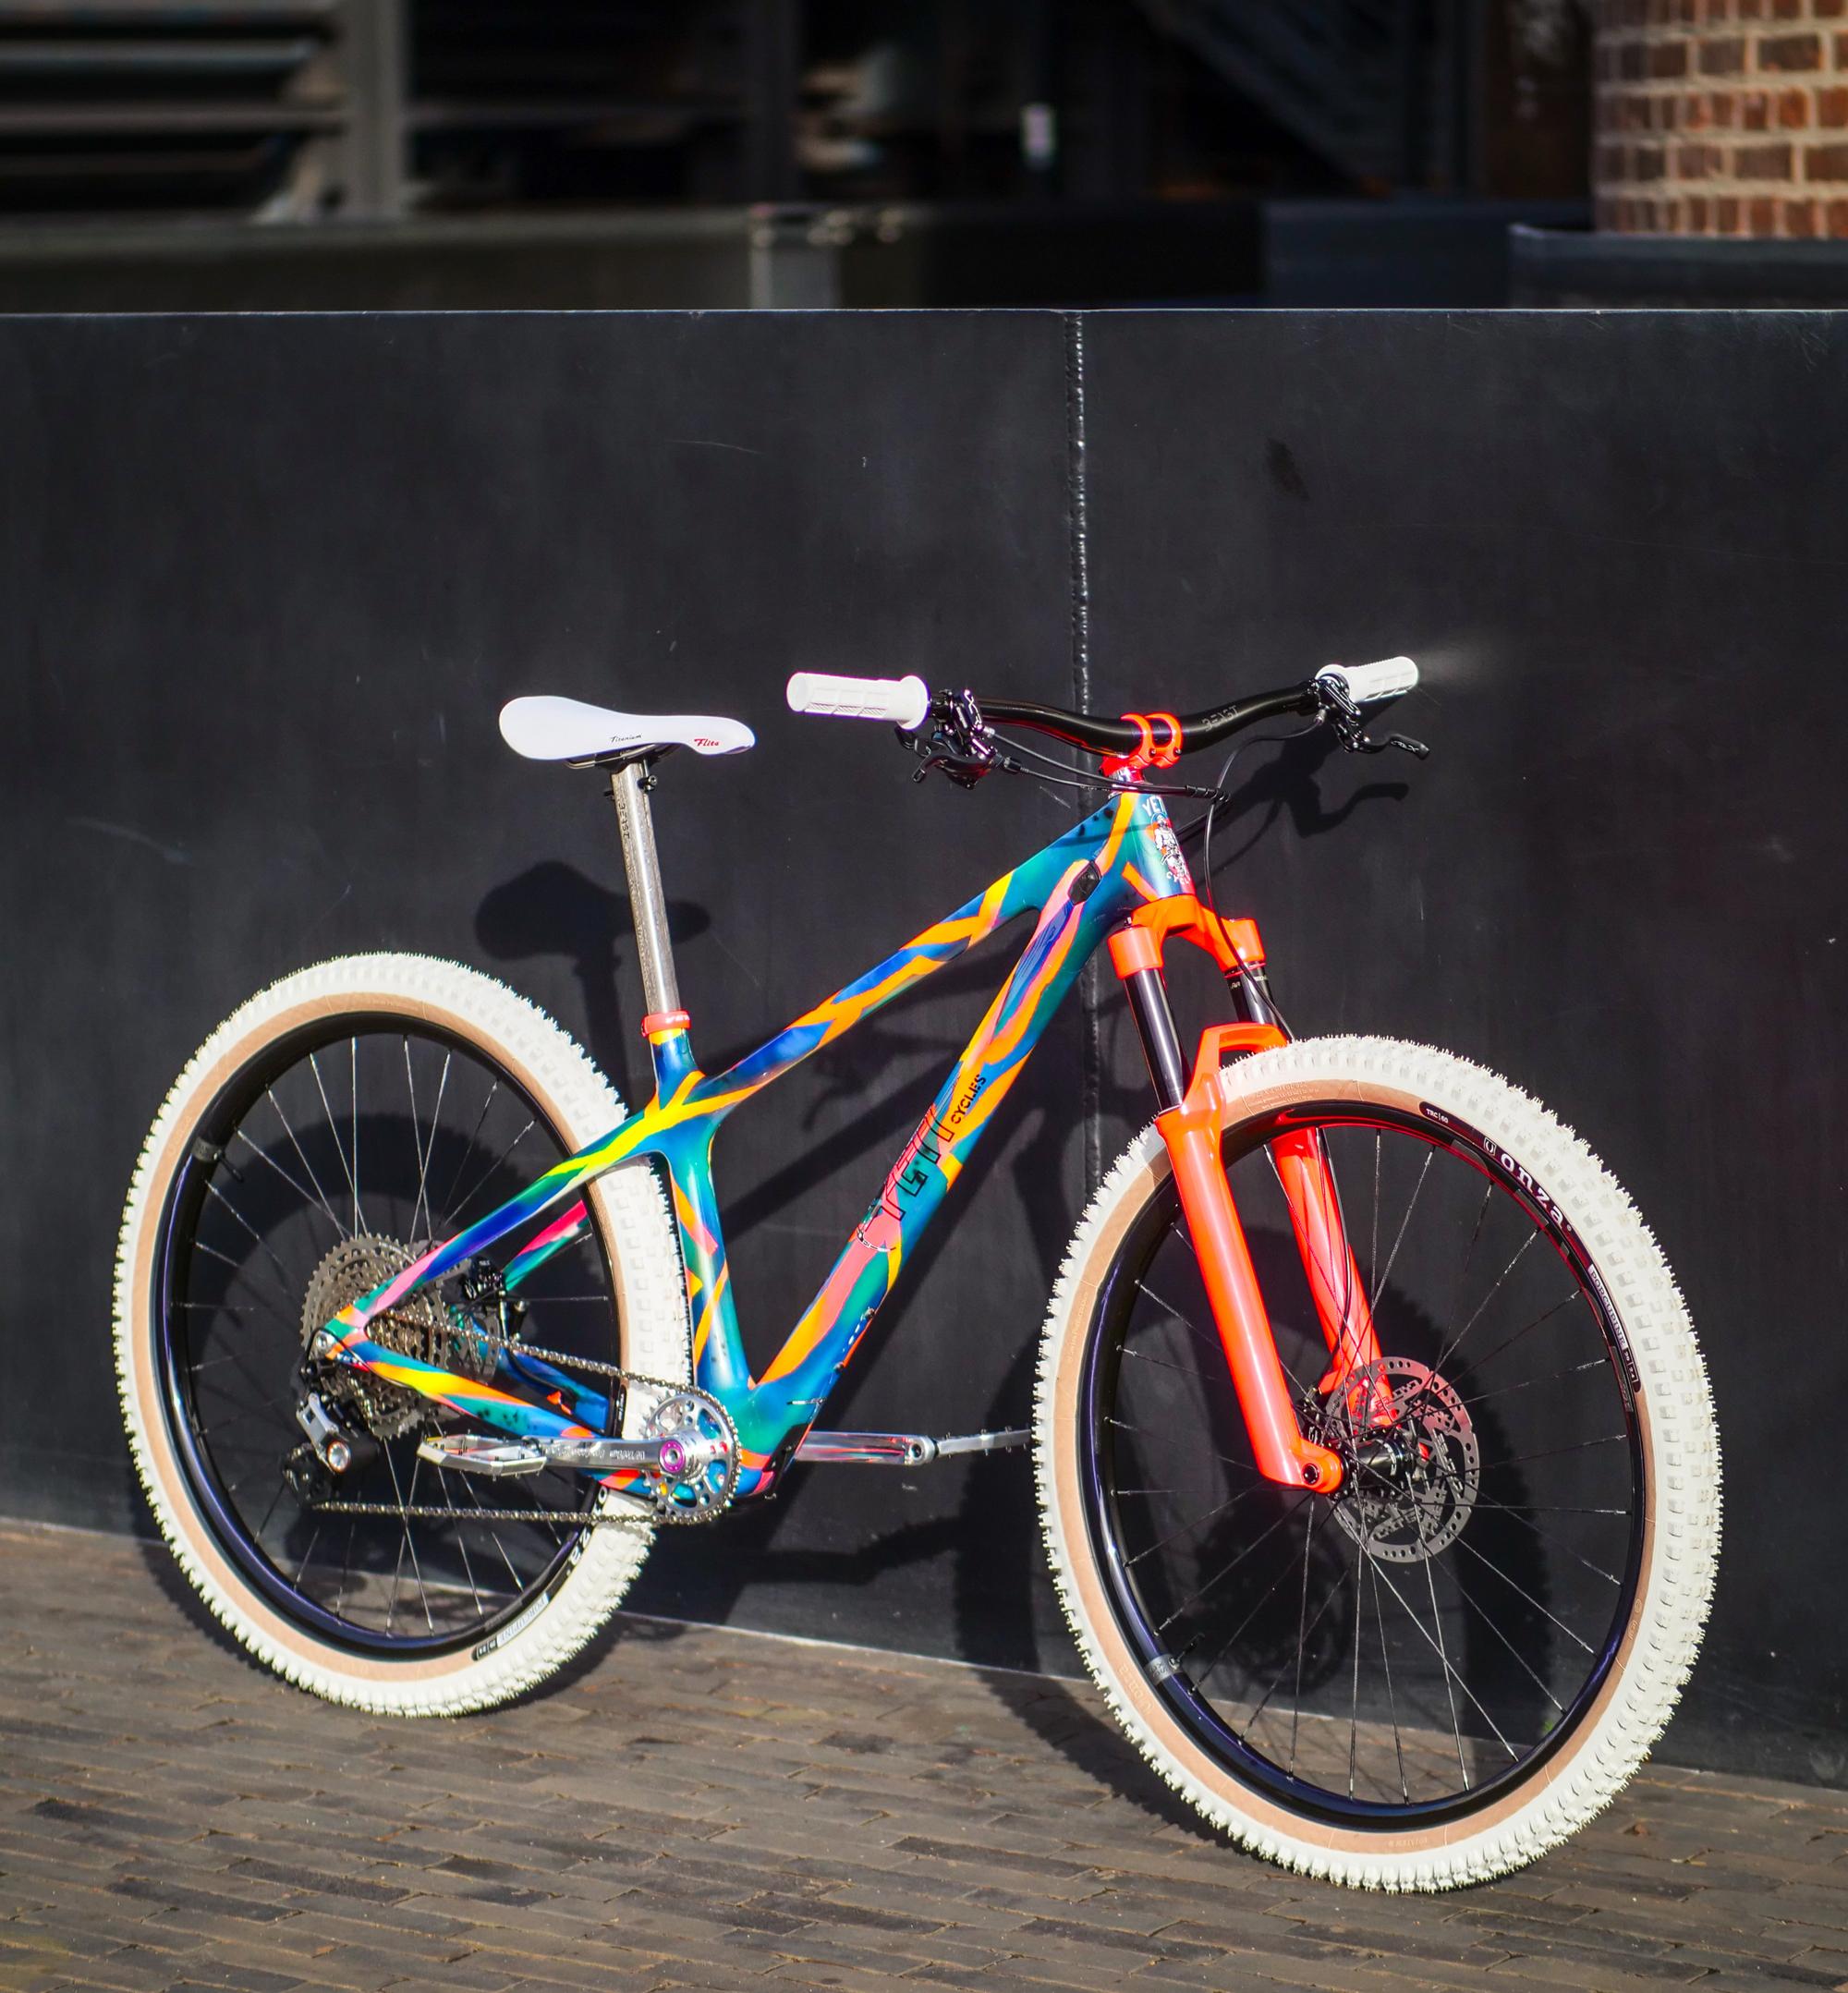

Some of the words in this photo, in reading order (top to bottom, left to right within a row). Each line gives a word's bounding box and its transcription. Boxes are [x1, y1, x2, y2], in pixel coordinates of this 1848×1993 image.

[694, 738, 720, 747] Flite
[1201, 705, 1241, 732] BEAST
[951, 1074, 986, 1124] CYCLES
[1500, 1153, 1564, 1230] onza
[1589, 1270, 1627, 1346] PORCUPINE
